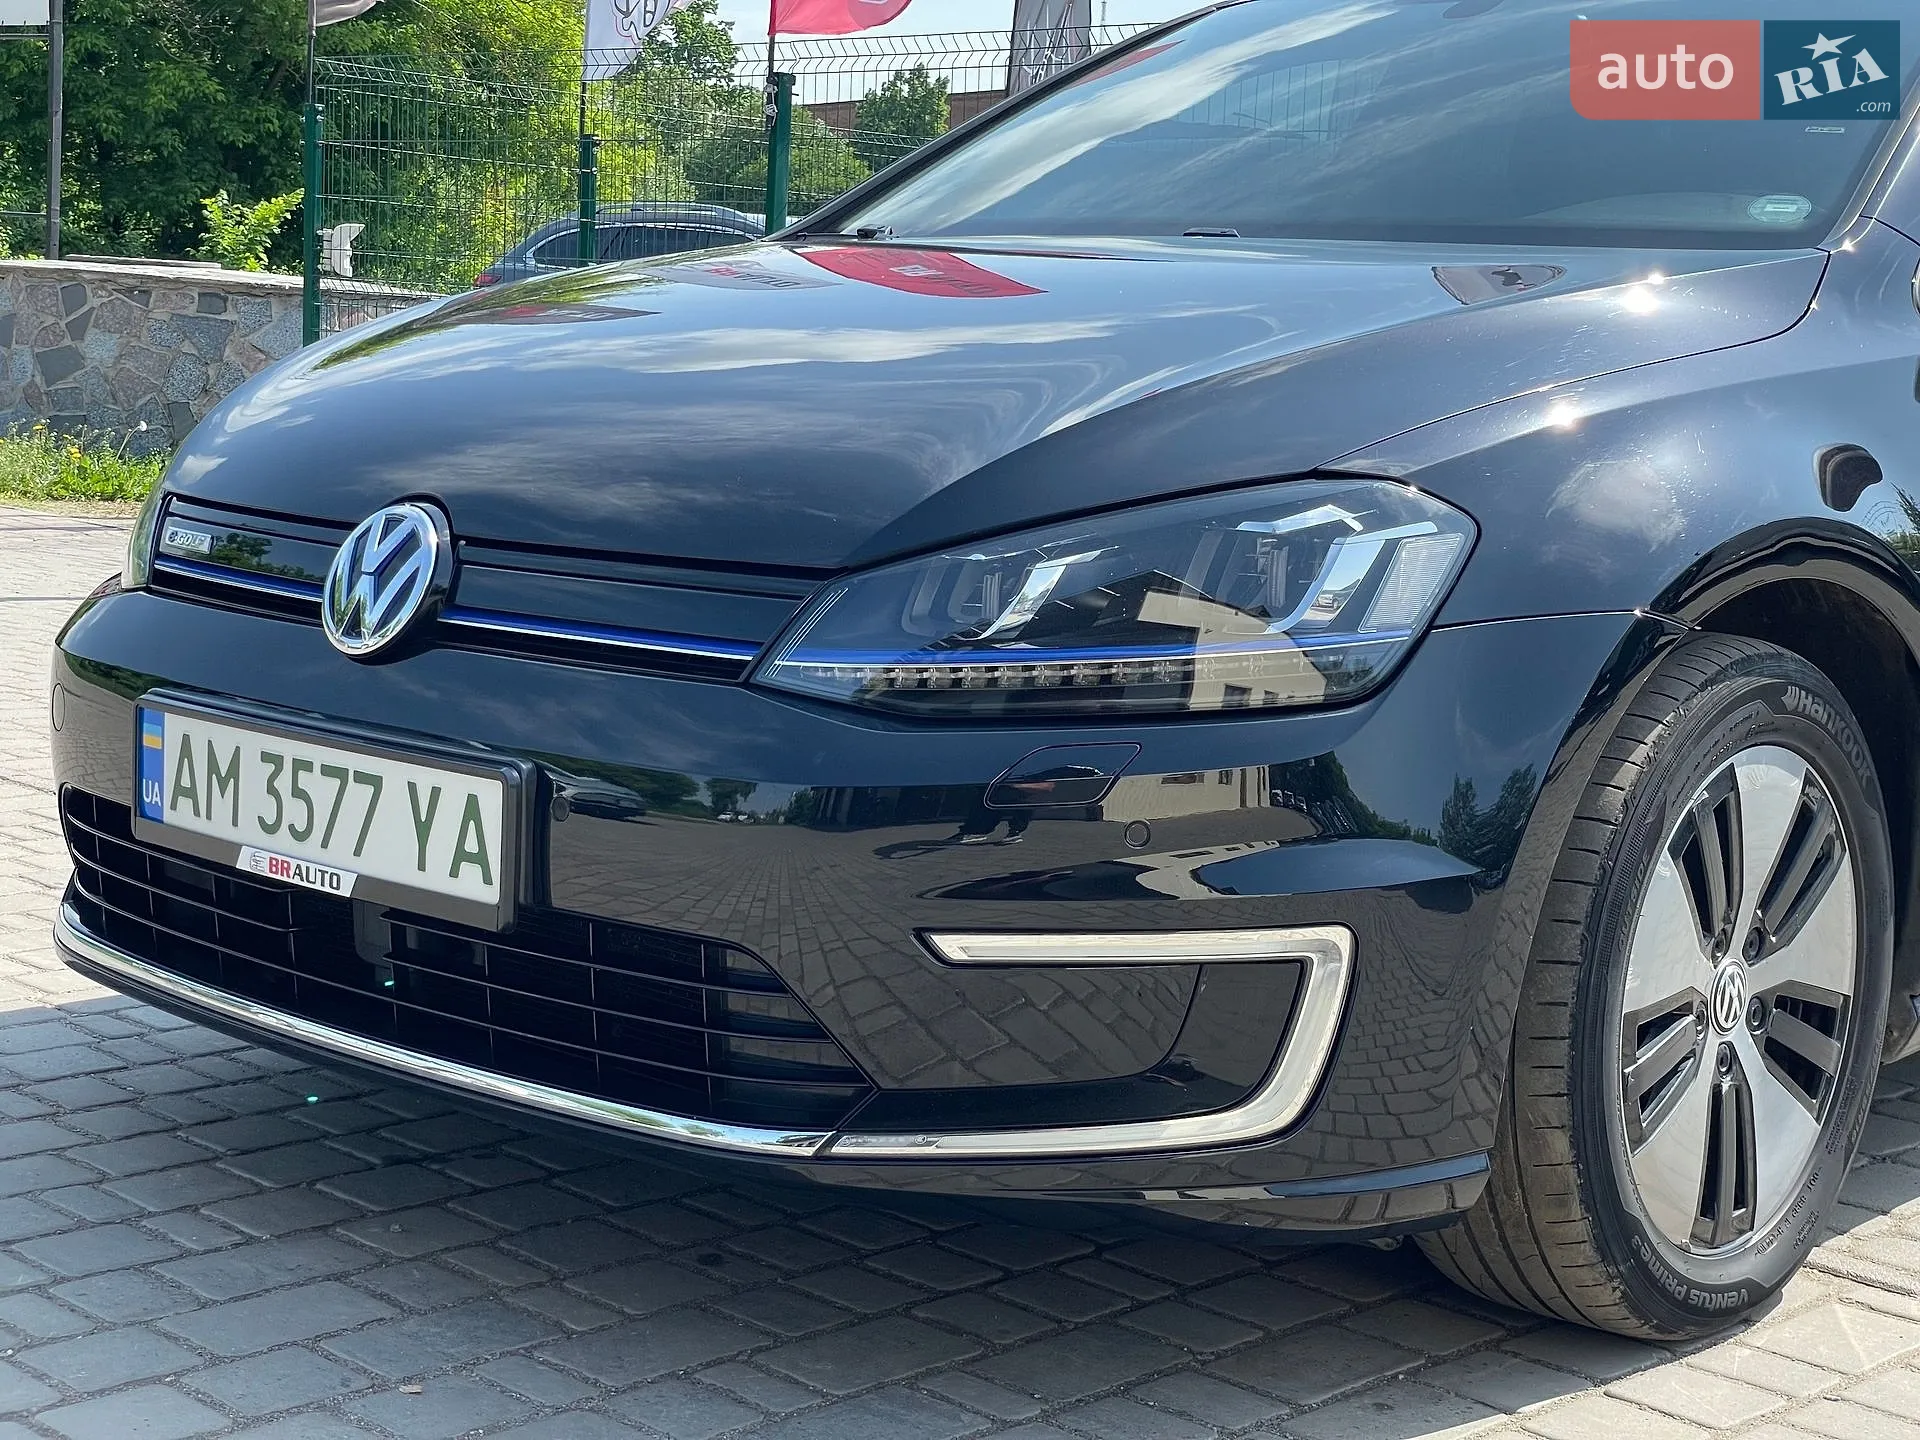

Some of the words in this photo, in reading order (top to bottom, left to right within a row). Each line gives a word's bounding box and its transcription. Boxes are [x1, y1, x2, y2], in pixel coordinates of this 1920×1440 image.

[142, 778, 162, 807] UA
[169, 733, 241, 828] AM
[257, 750, 383, 858] 3577
[407, 780, 493, 886] YA
[267, 856, 342, 891] BRAUTO
